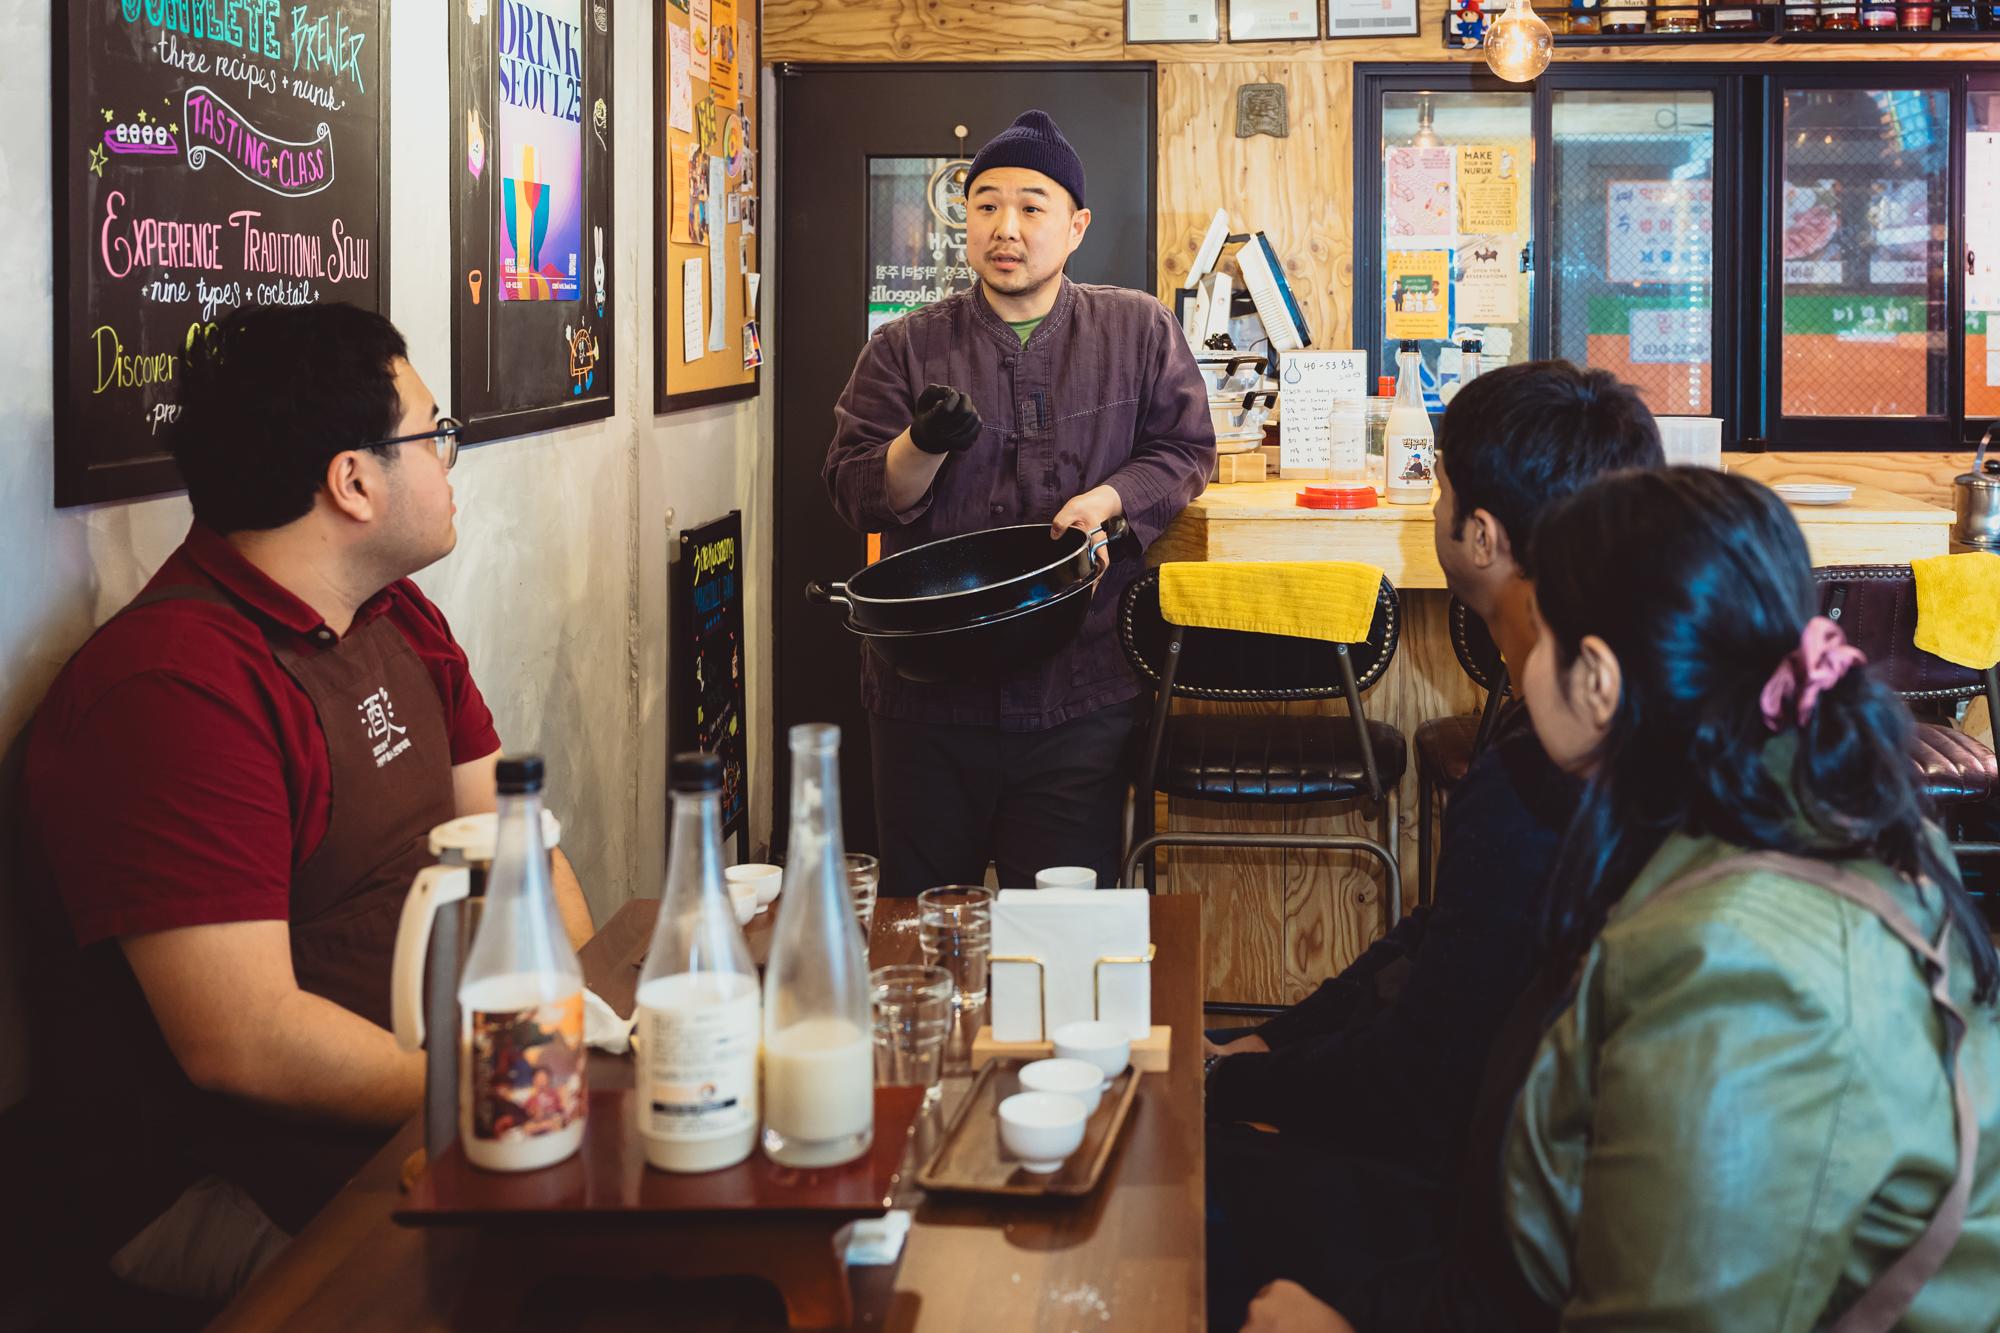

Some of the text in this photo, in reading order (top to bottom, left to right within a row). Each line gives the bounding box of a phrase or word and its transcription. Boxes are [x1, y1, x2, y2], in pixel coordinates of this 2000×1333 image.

[158, 30, 211, 73] three
[215, 53, 276, 99] recipes
[292, 5, 365, 93] BREWER
[500, 0, 580, 79] DRINK
[188, 95, 324, 187] TASTING CLASS
[1464, 152, 1493, 160] MAKE
[102, 191, 369, 282] EXPERIENCE TRADITIONAL SOJU
[151, 273, 190, 303] nine
[196, 276, 241, 321] types
[257, 278, 314, 306] cocktail
[91, 325, 178, 393] Discover
